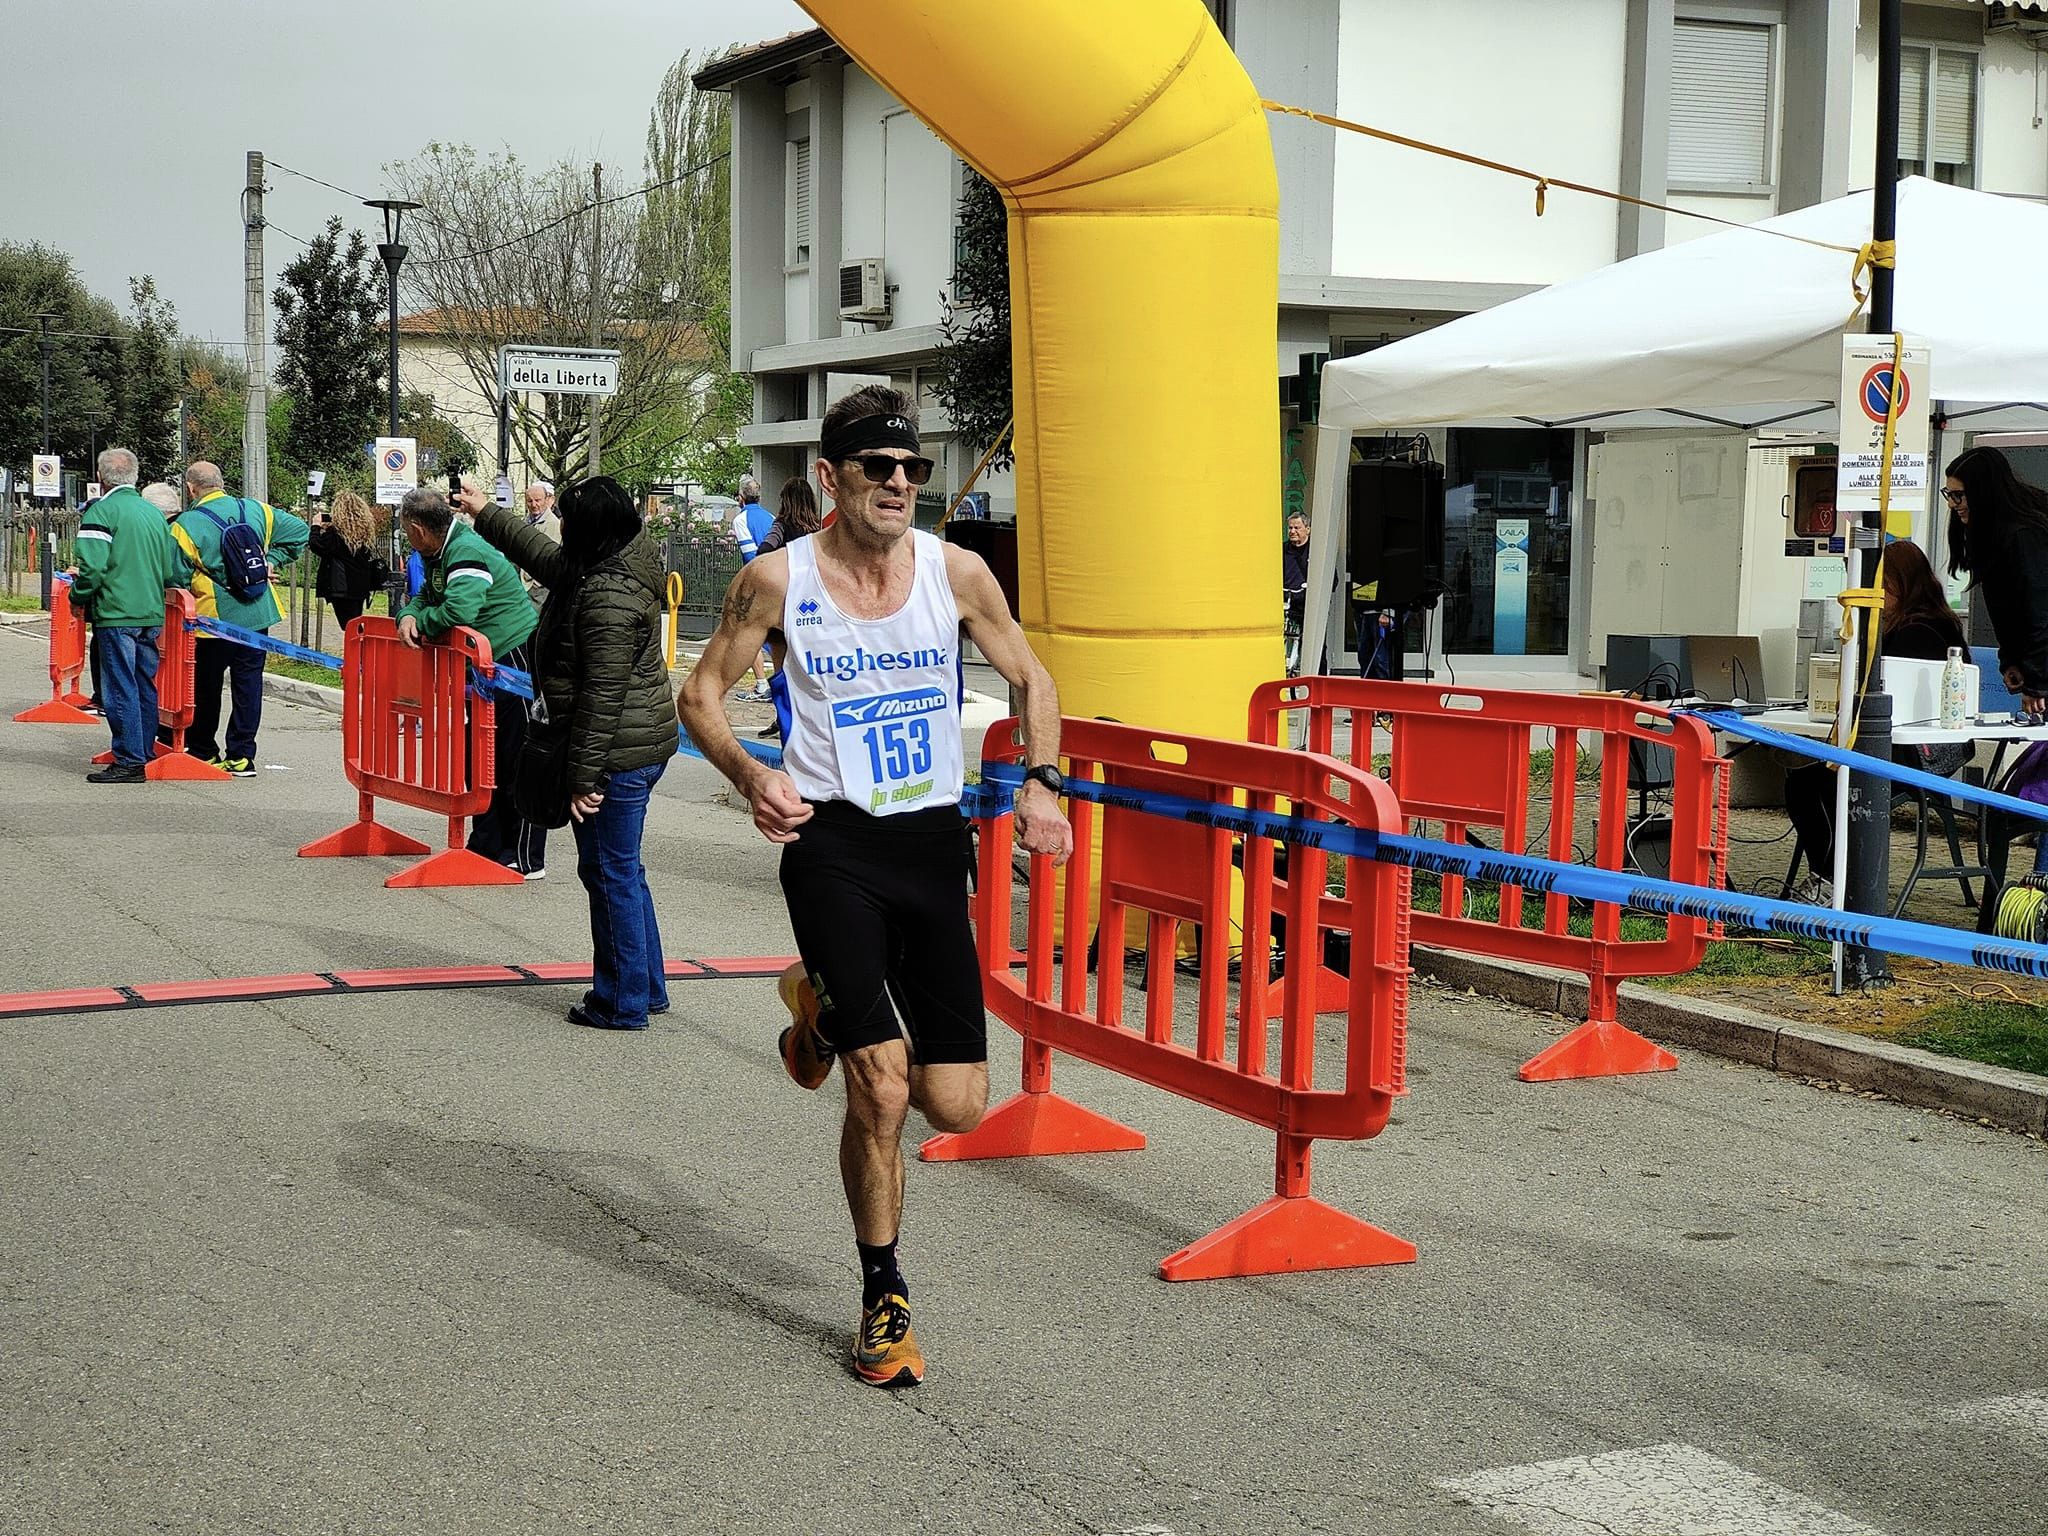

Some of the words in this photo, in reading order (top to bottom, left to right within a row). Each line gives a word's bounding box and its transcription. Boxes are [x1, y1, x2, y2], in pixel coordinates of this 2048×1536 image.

[513, 358, 533, 366] viale
[513, 367, 549, 384] della
[556, 369, 607, 387] Liberta
[1858, 454, 1878, 462] DALLE
[1499, 528, 1526, 537] LAILA
[862, 717, 932, 784] 153
[1413, 849, 1473, 878] TUBAZIONI
[1475, 860, 1558, 891] ATTENZIONE
